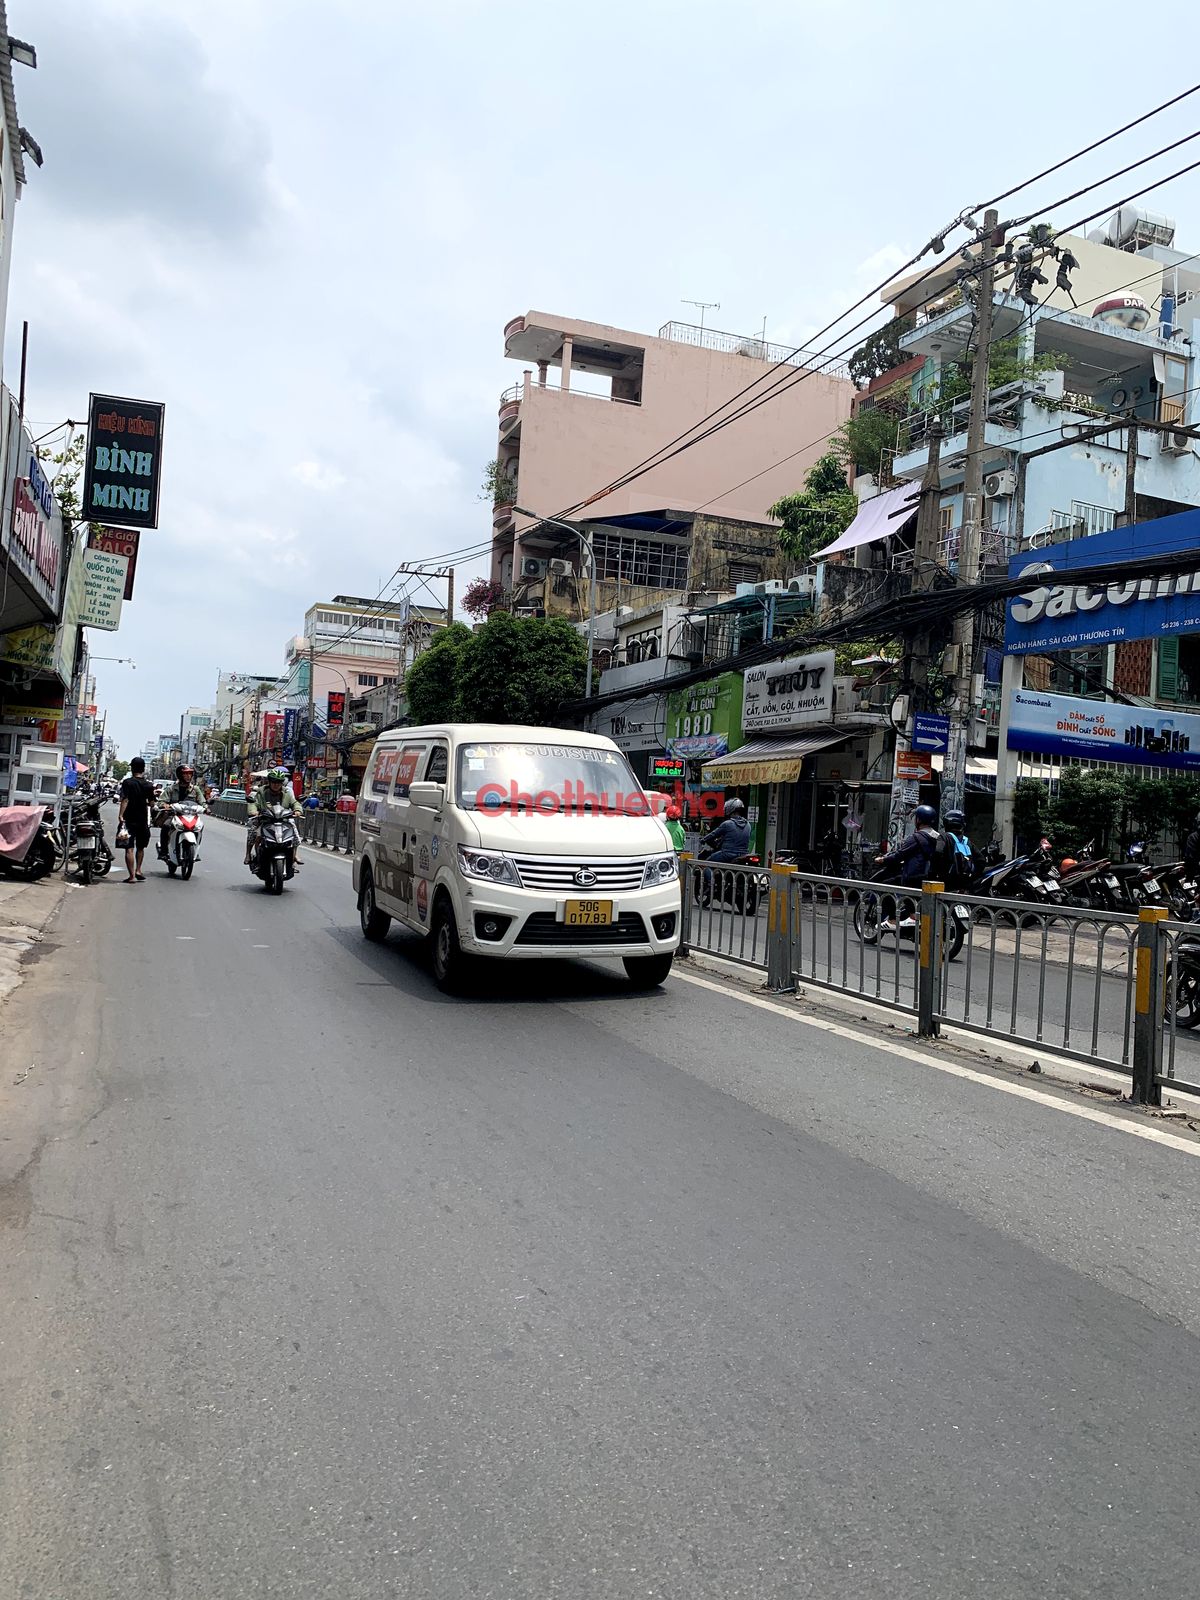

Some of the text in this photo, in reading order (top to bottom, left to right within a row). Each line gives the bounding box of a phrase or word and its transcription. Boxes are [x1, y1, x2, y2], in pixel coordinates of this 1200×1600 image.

[94, 441, 153, 476] BÌNH
[92, 482, 151, 512] MINH
[92, 540, 135, 557] BALO
[94, 554, 110, 563] CÔNG
[86, 560, 105, 573] QUỐC
[103, 592, 117, 601] INOX
[1011, 562, 1200, 623] Sacom
[1008, 626, 1125, 651] NGÂN HÀNG SÀI GÒN THƯƠNG TÍN
[746, 671, 767, 683] SALON
[746, 702, 761, 716] CẮT,
[798, 695, 825, 709] NHUỘM
[1015, 694, 1052, 708] Sacombank
[1095, 713, 1105, 724] SỐ
[675, 713, 712, 739] 1980
[916, 722, 948, 735] Sacombank
[1092, 724, 1116, 737] SỐNG
[579, 901, 599, 912] 50G
[570, 912, 607, 924] 017.83
